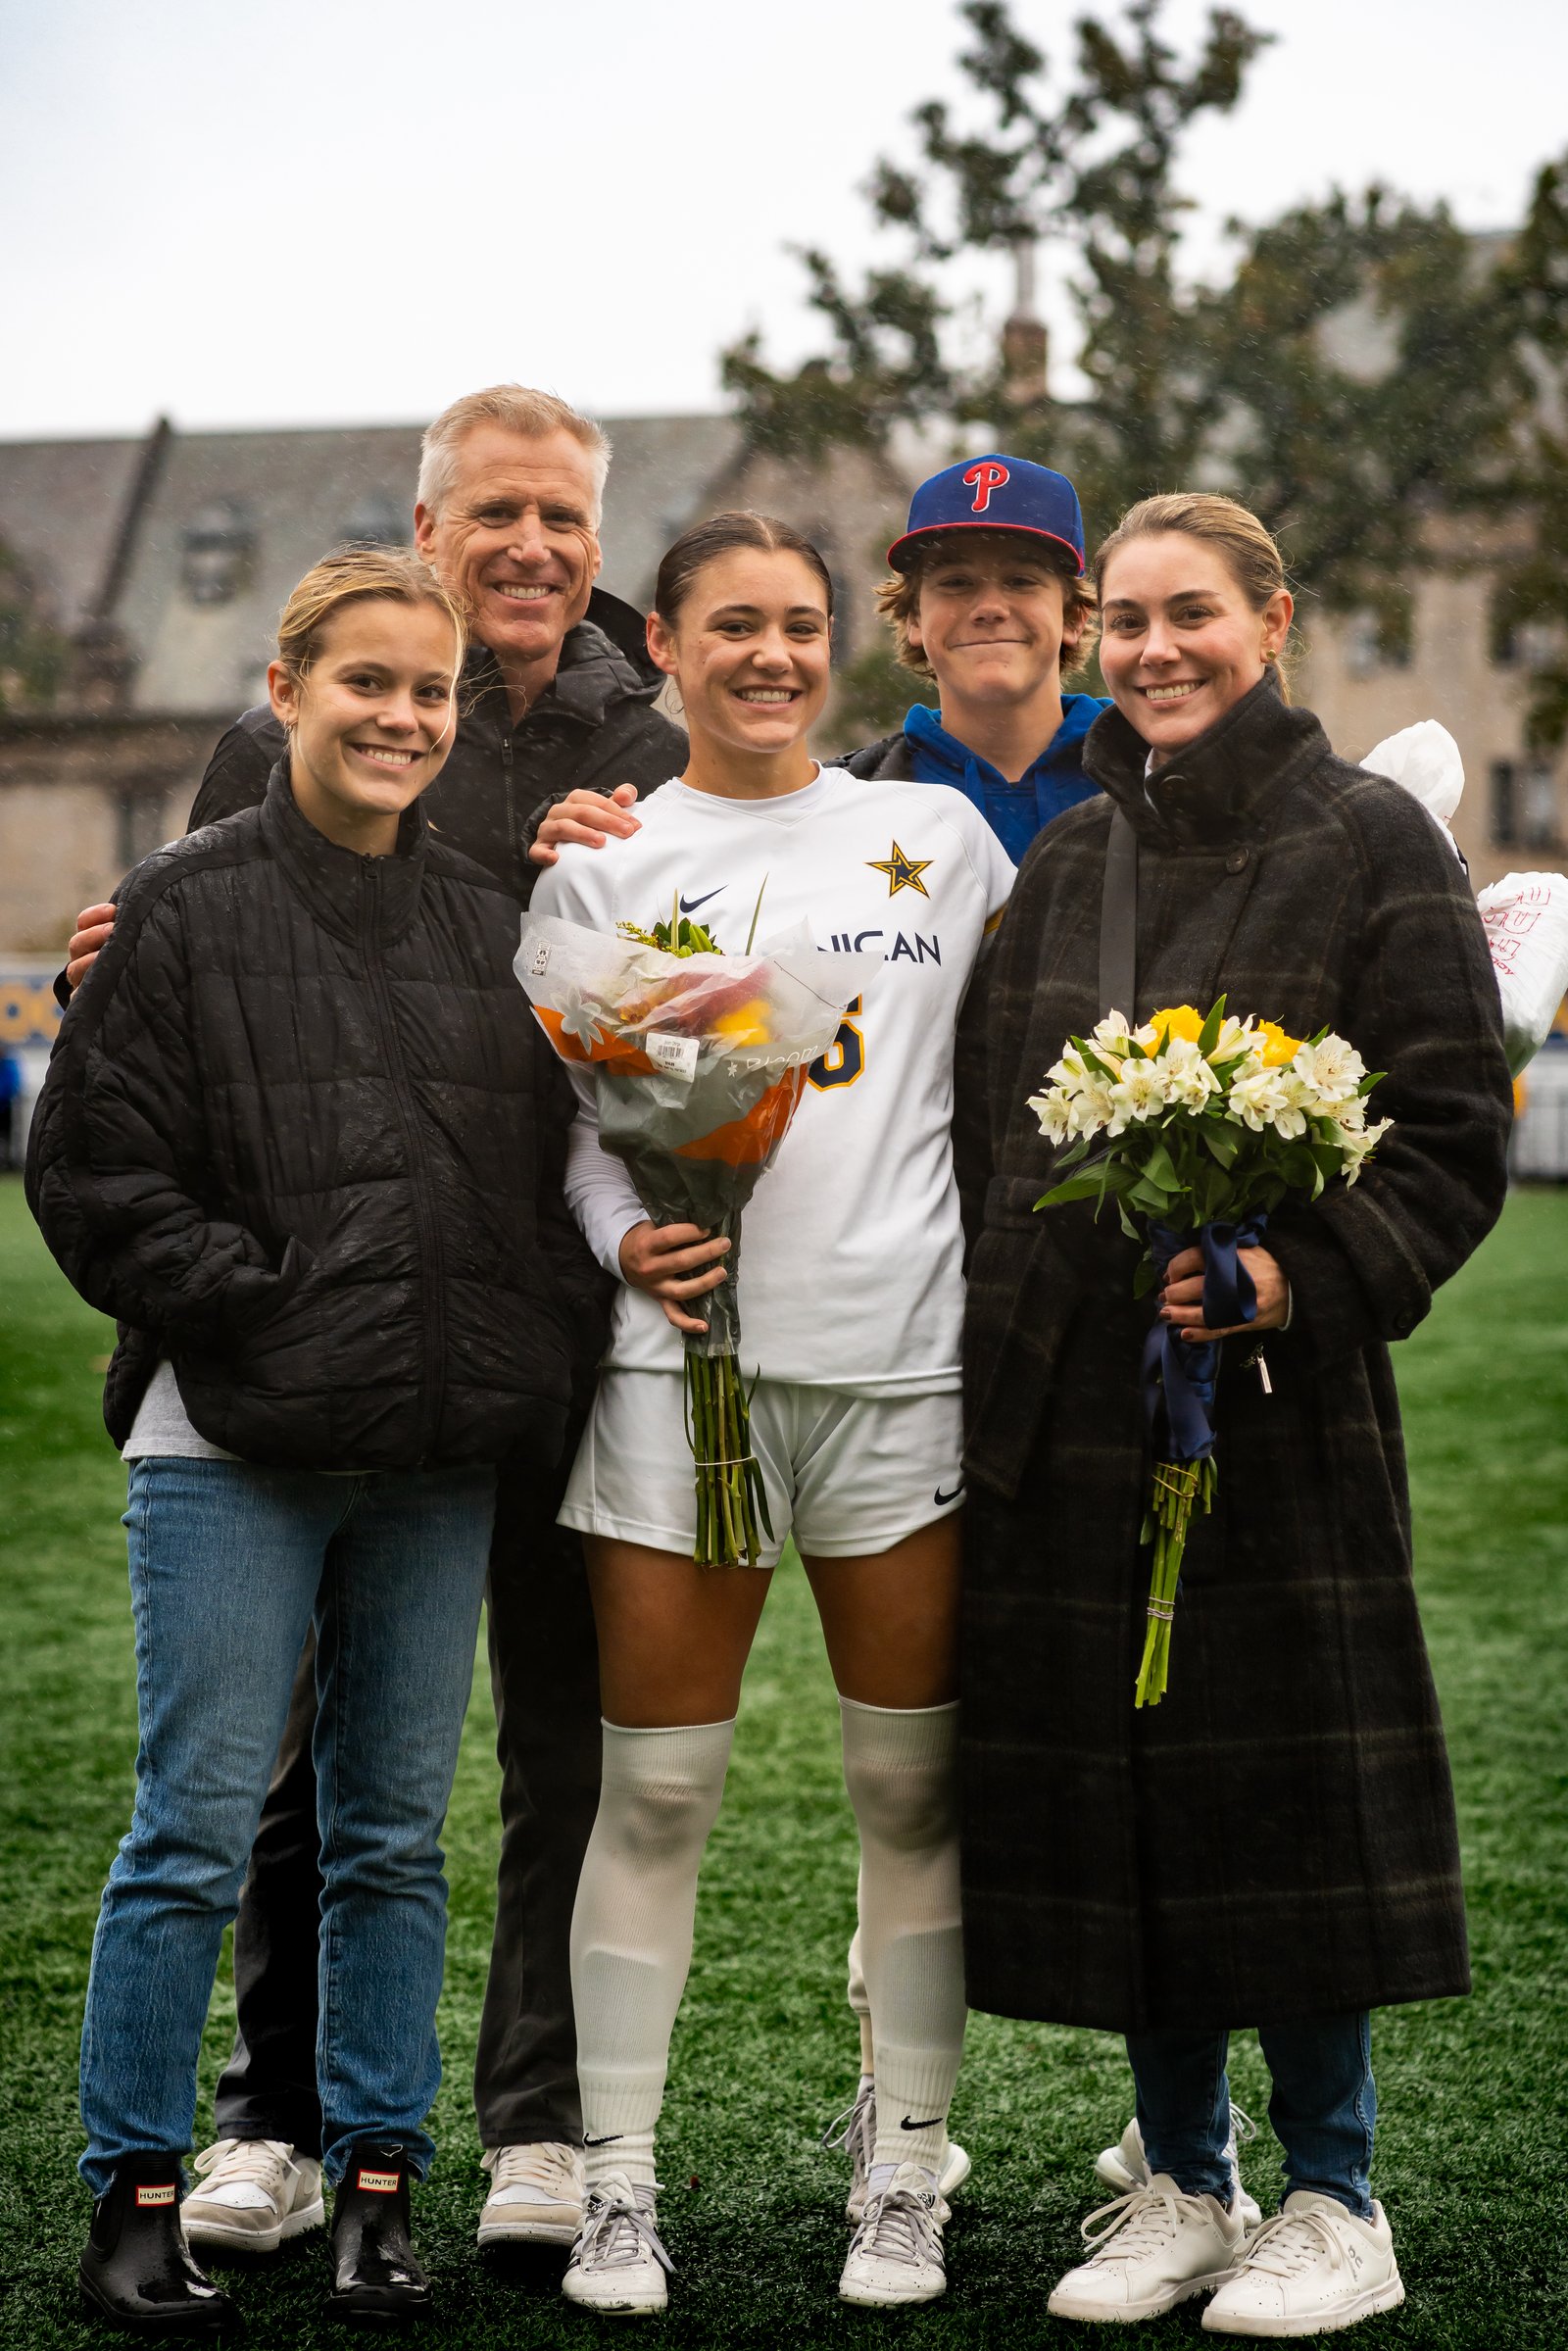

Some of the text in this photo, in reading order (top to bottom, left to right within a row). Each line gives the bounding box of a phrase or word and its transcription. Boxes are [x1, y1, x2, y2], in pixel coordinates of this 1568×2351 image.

[963, 462, 1009, 513] P
[360, 2177, 397, 2186] HUNTER
[139, 2190, 174, 2199] HUNTER
